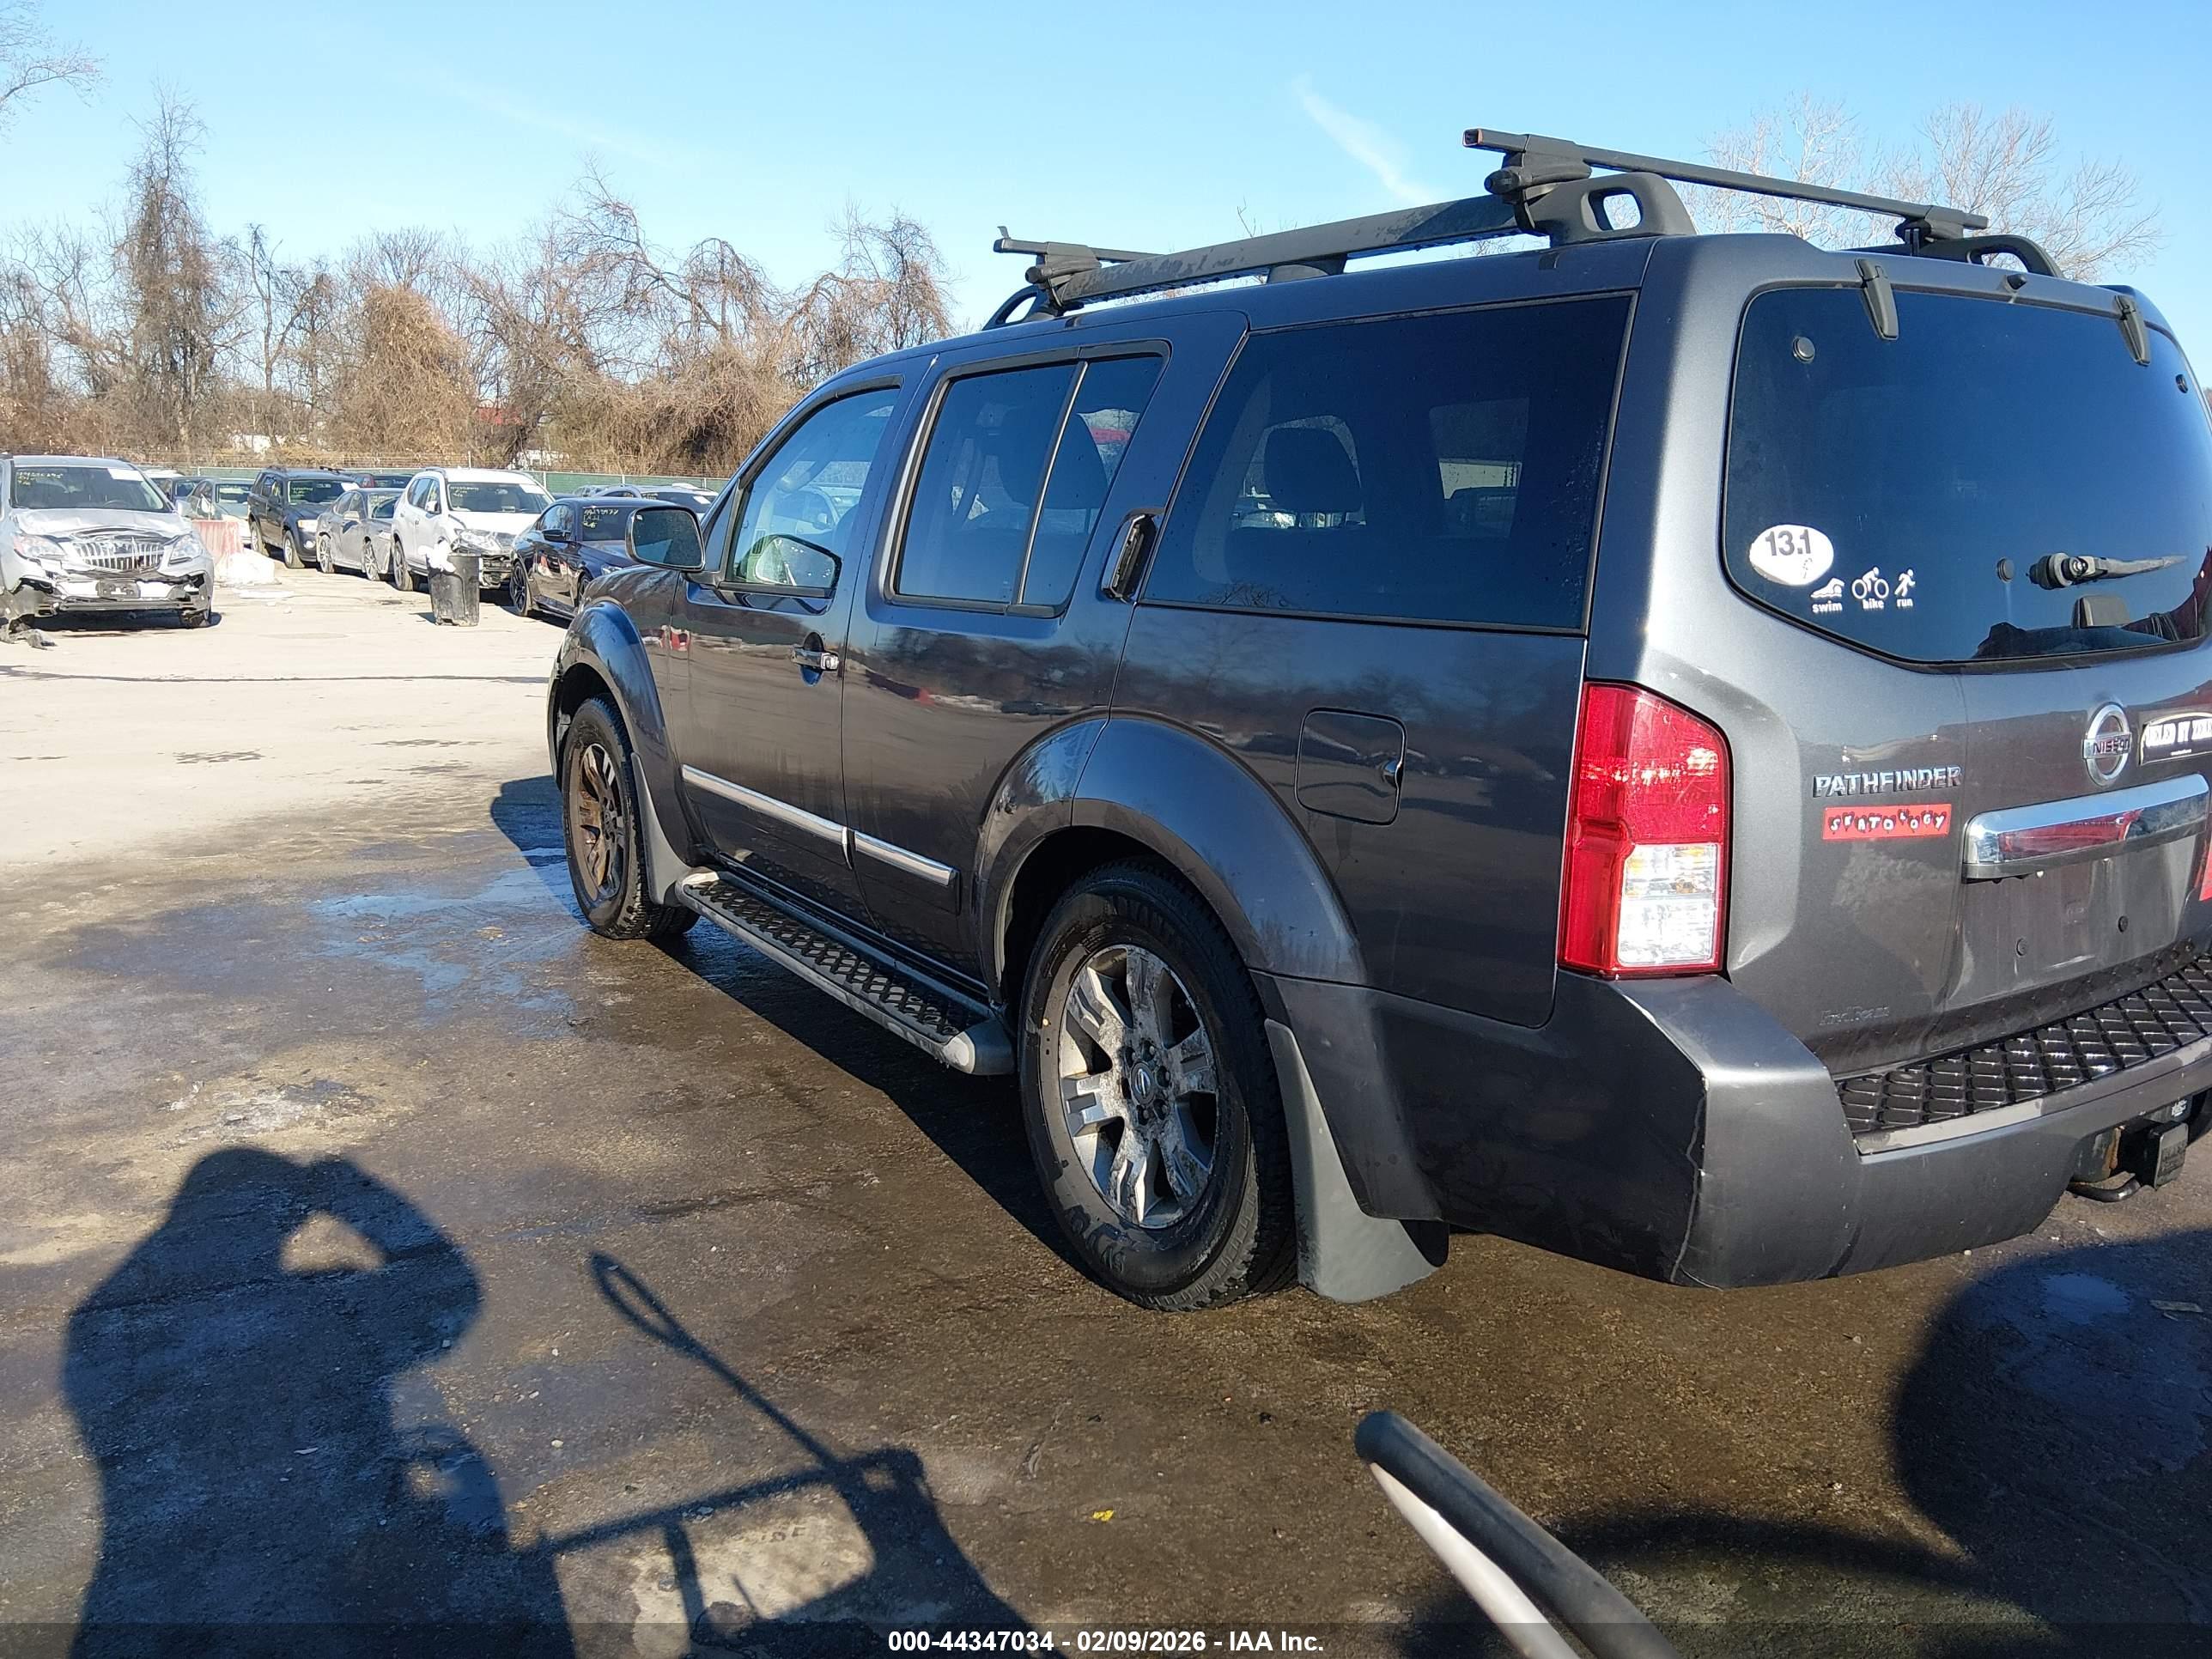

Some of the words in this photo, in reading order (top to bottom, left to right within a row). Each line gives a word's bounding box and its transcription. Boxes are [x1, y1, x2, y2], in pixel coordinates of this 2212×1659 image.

[1765, 528, 1812, 556] 13.1
[1812, 600, 1843, 613] swim
[1863, 598, 1885, 610] bike
[1896, 598, 1913, 608] run
[2093, 738, 2130, 756] NISSAN
[1813, 766, 1962, 798] PATHFINDER
[1829, 811, 1946, 832] SKATOLOGY
